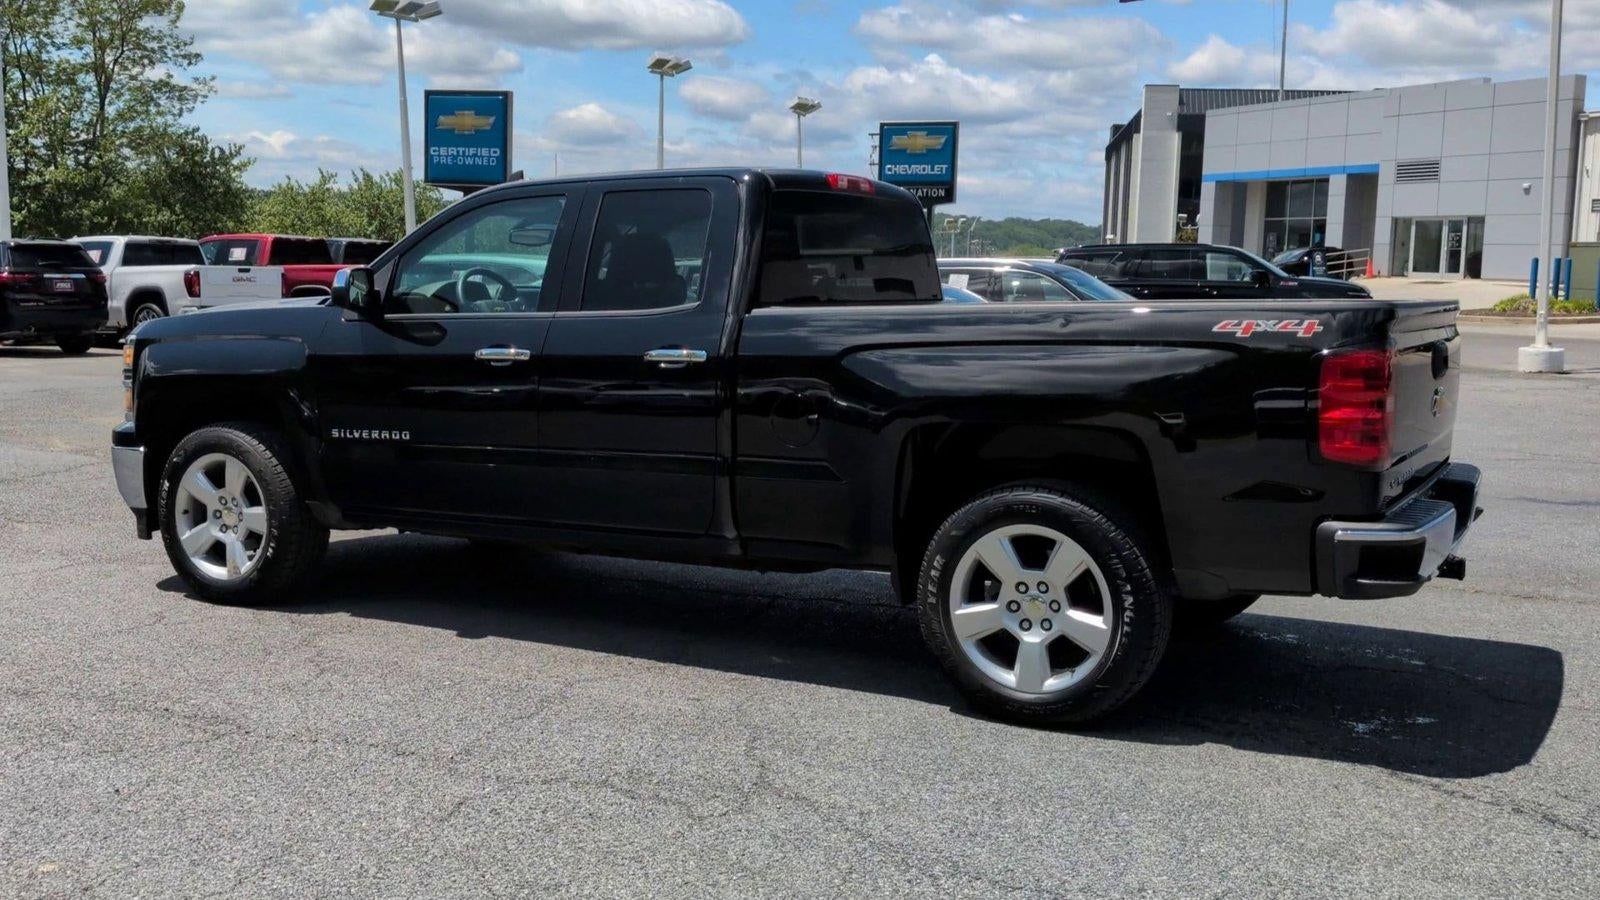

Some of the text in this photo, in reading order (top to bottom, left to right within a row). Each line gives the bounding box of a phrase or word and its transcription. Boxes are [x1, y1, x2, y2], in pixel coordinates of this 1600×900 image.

[430, 147, 500, 156] CERTIFIED
[433, 156, 497, 166] PRE-OWNED
[885, 164, 948, 175] CHEVROLET
[331, 428, 410, 440] SILVERADO
